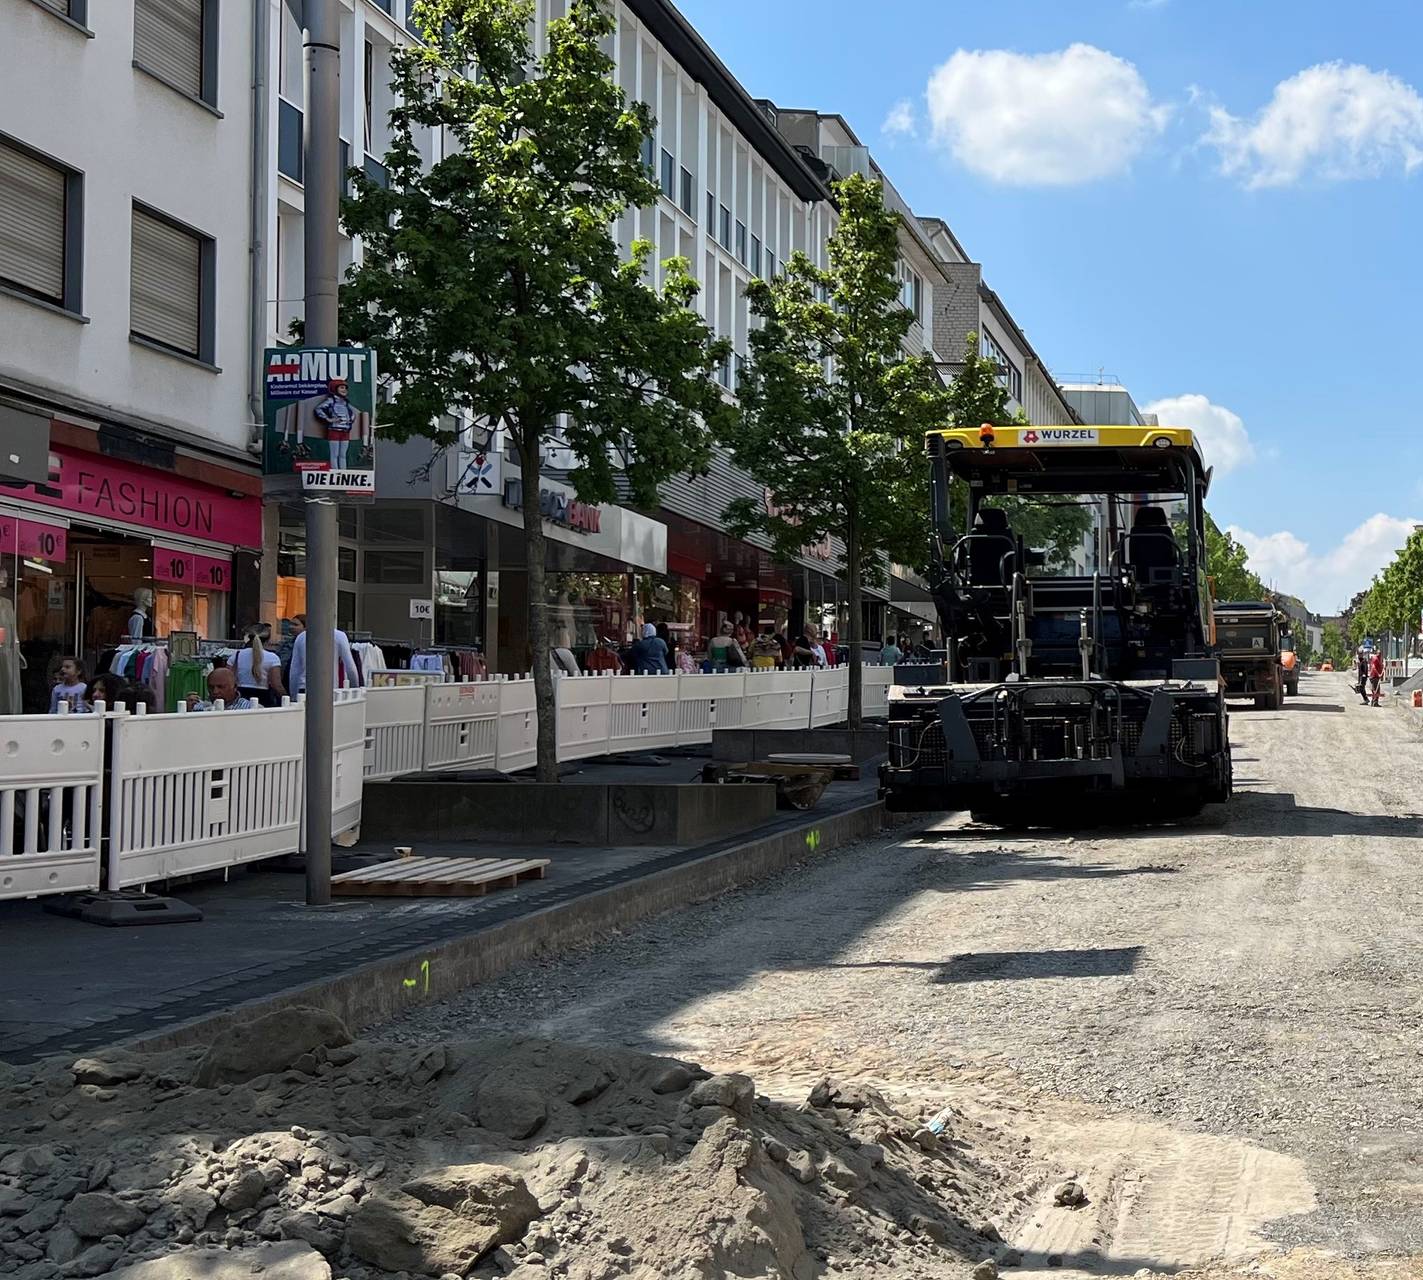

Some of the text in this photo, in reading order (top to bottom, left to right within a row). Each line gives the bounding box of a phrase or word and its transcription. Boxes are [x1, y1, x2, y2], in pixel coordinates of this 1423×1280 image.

[267, 352, 366, 383] ARMUT
[1041, 430, 1095, 439] WURZEL
[306, 473, 328, 485] DIE
[78, 471, 213, 534] FASHION
[415, 605, 431, 613] 10€
